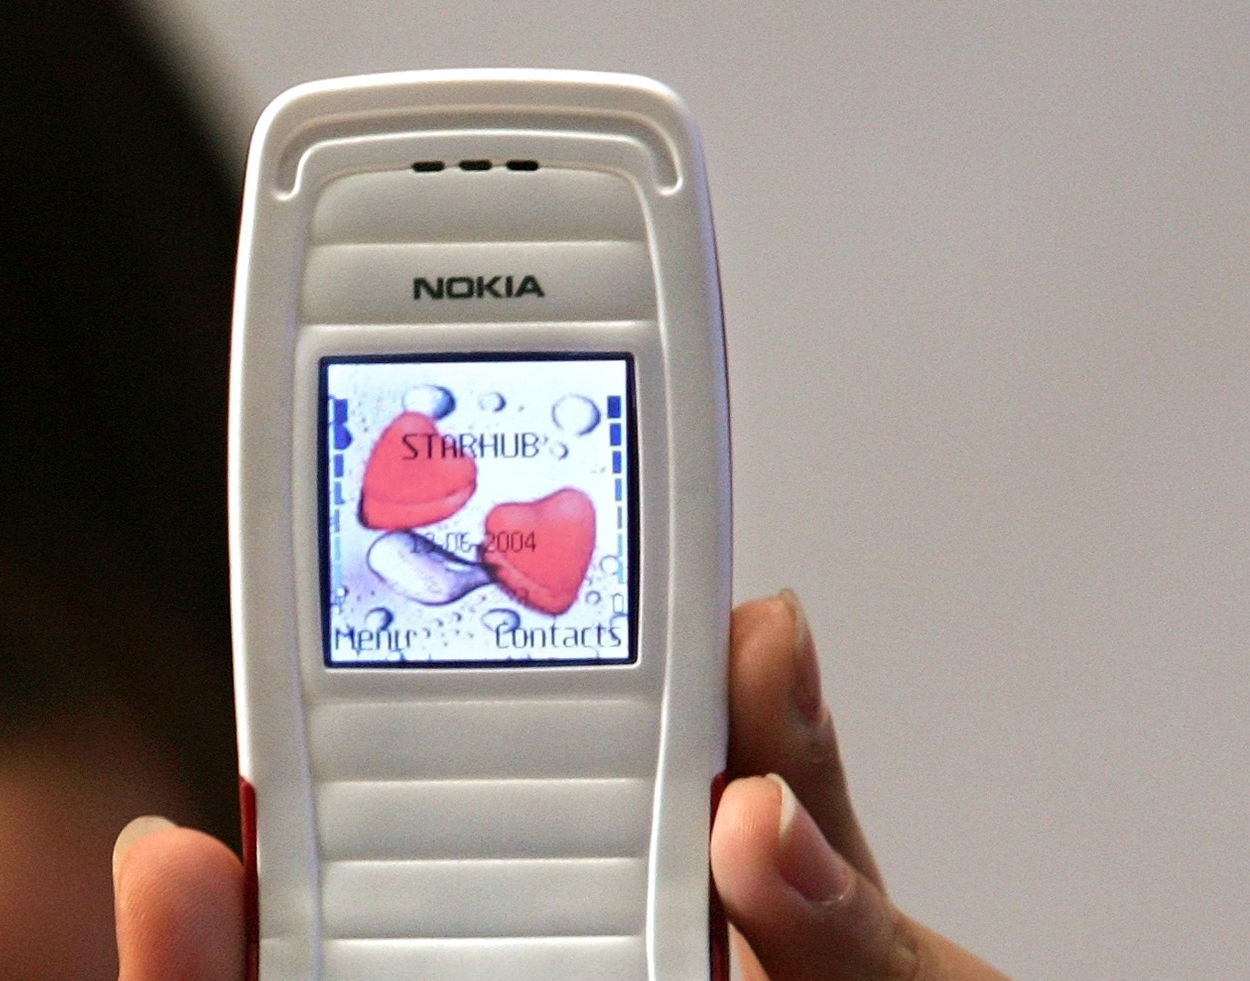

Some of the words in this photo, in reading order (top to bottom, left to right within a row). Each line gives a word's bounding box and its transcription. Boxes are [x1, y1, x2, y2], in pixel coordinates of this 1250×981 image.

[413, 275, 545, 300] NOKIA
[402, 432, 541, 460] STARHUB
[335, 625, 414, 651] Menu
[496, 620, 622, 649] Contacts
